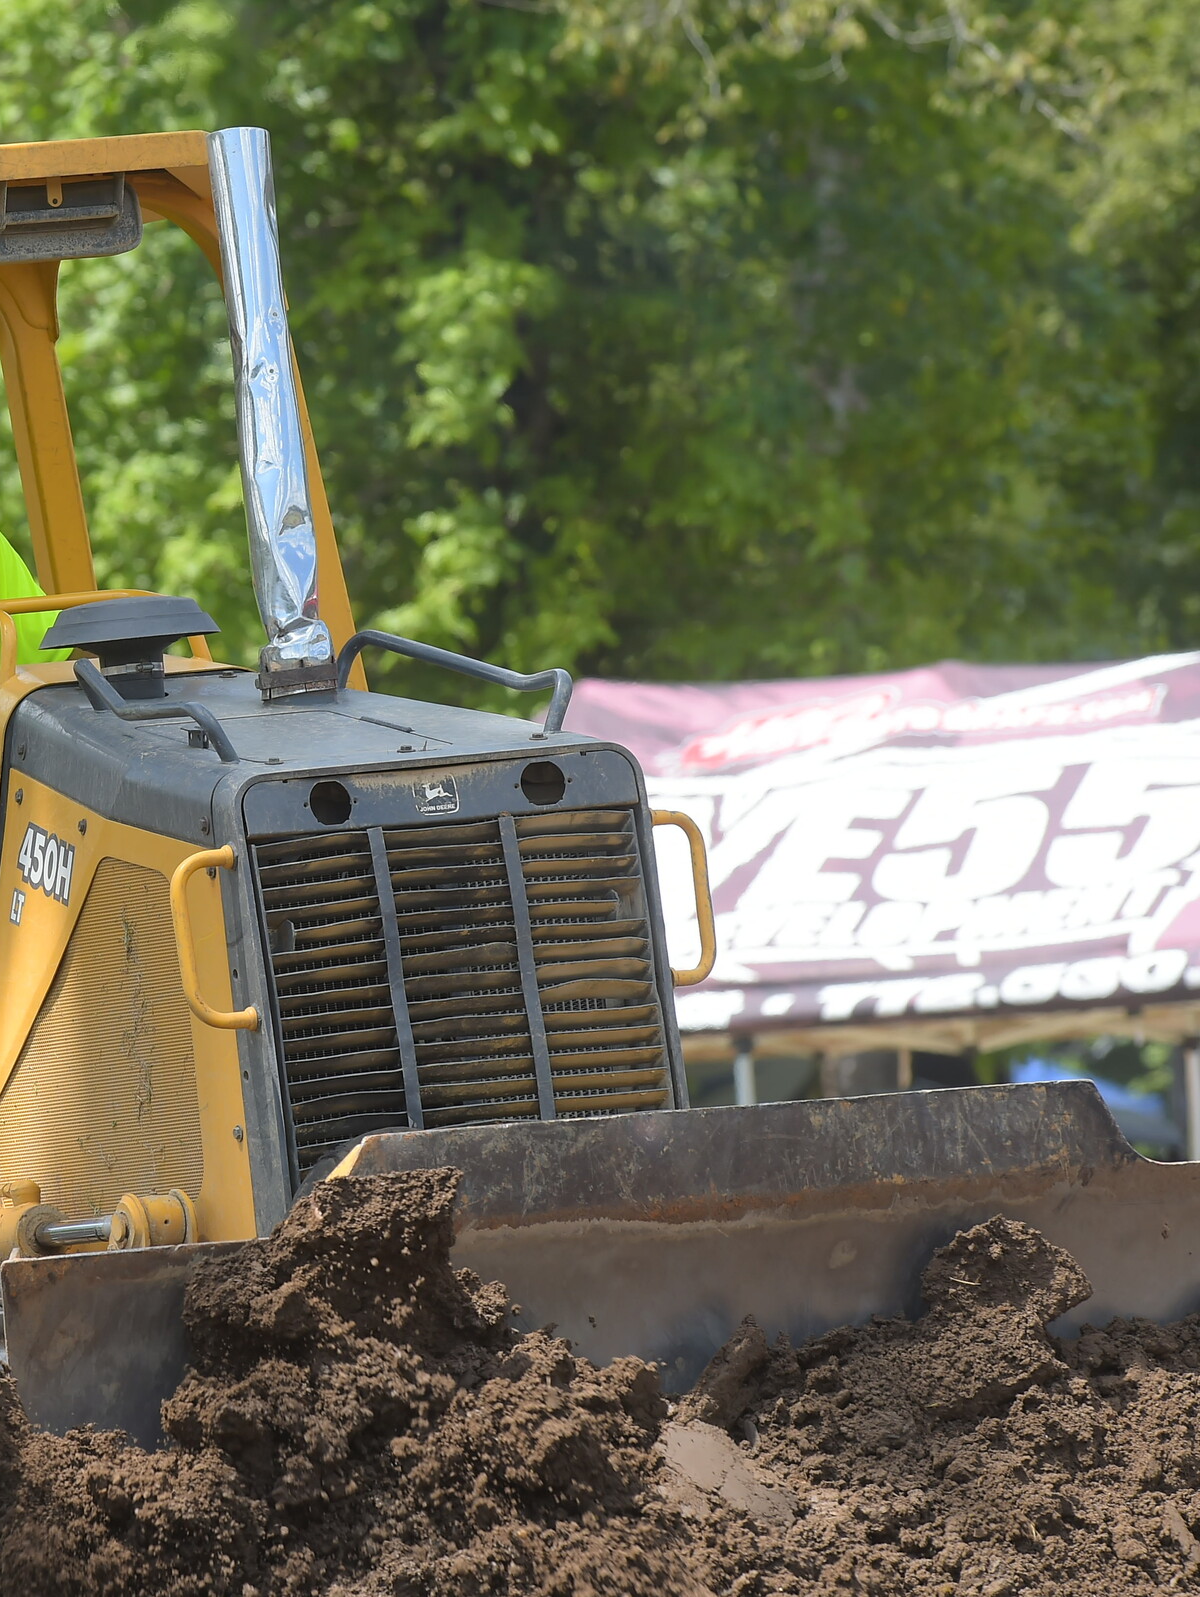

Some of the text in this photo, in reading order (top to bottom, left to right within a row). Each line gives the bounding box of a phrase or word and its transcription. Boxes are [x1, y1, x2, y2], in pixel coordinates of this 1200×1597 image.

[436, 803, 456, 811] DEERE
[18, 825, 74, 902] 450H
[10, 890, 25, 923] LT
